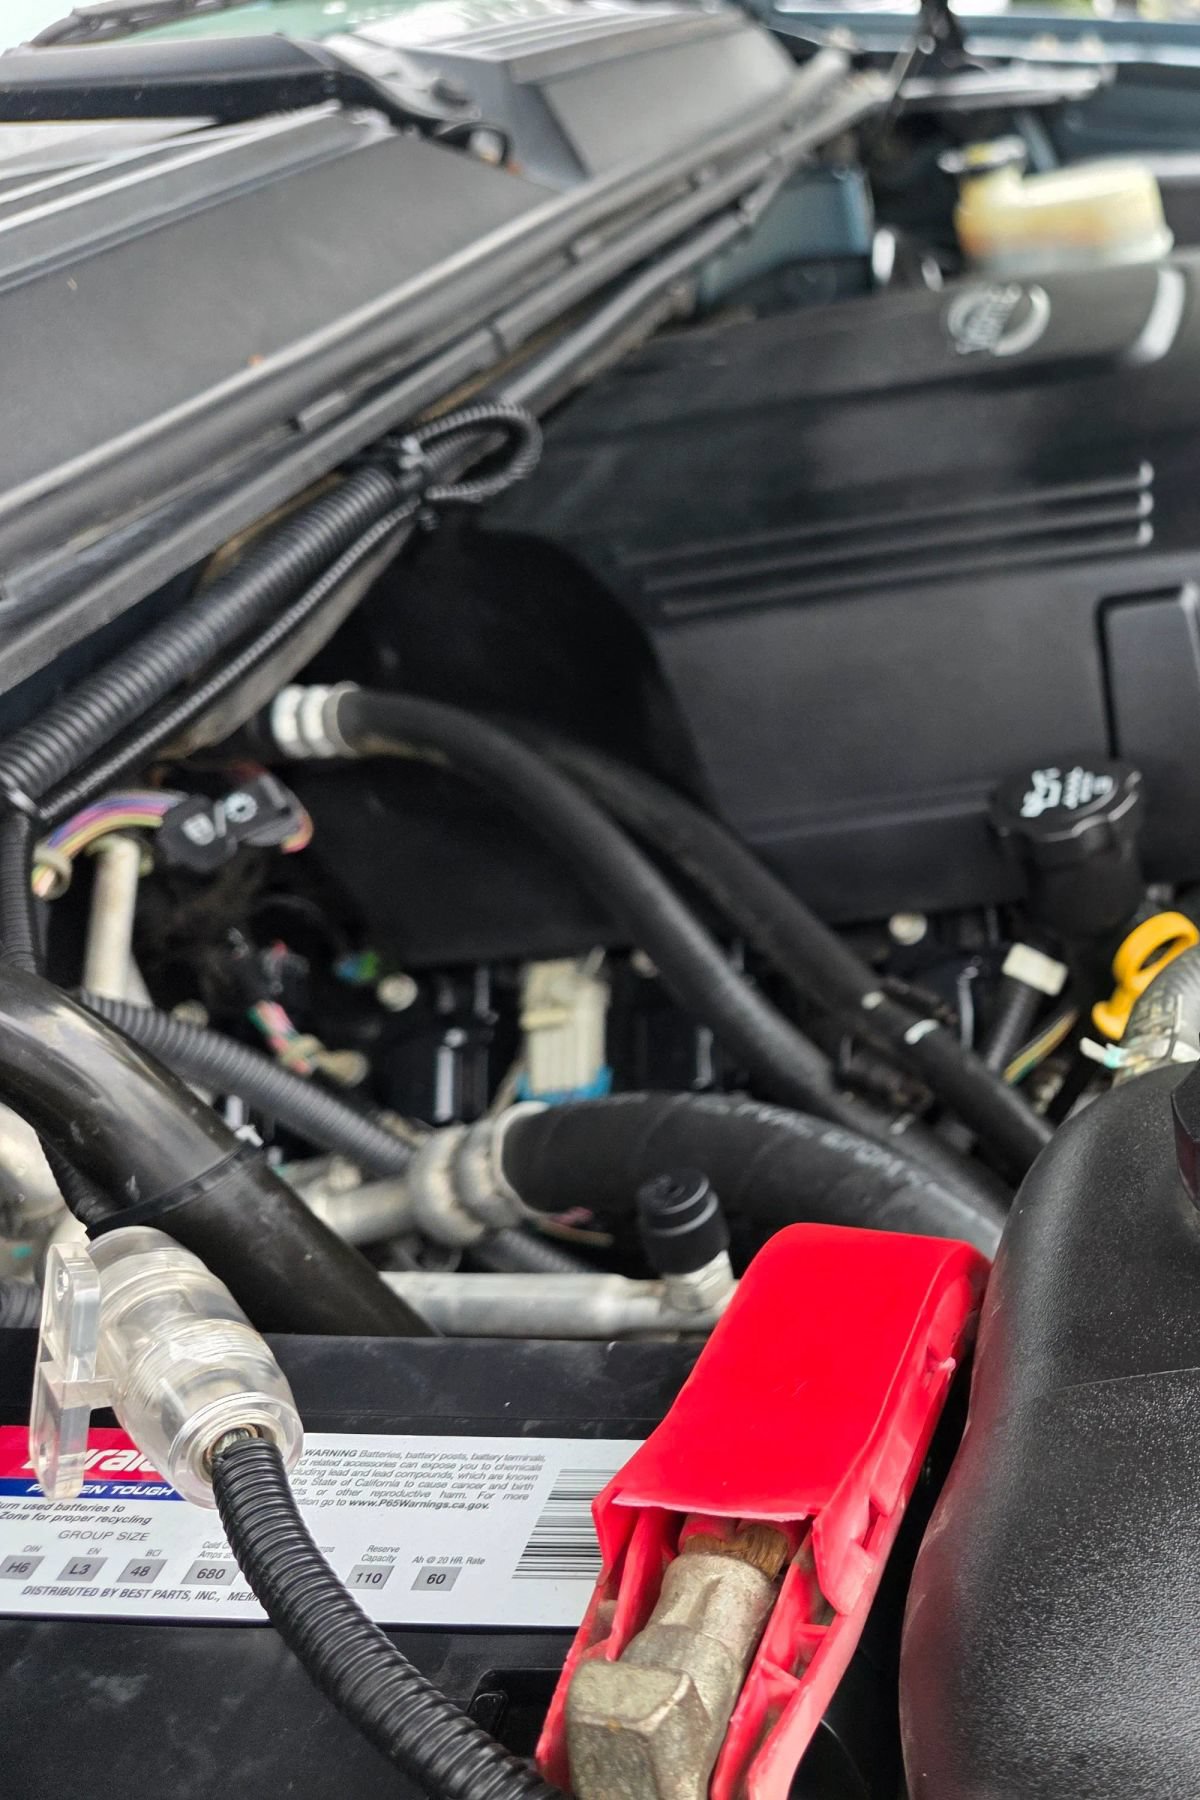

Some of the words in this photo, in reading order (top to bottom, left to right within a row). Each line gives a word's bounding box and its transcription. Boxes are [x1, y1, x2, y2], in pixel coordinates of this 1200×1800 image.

[304, 1449, 357, 1458] WARNING
[404, 1452, 438, 1461] battery
[309, 1459, 340, 1467] related
[343, 1460, 397, 1468] accessories
[421, 1462, 456, 1470] expose
[458, 1463, 478, 1471] you
[481, 1462, 491, 1470] to
[494, 1463, 543, 1471] chemicals
[351, 1469, 371, 1477] and
[372, 1469, 394, 1477] lead
[395, 1471, 454, 1480] compounds,
[458, 1471, 486, 1480] which
[505, 1472, 538, 1480] known
[311, 1478, 337, 1486] State
[341, 1478, 352, 1486] of
[355, 1479, 400, 1487] California
[418, 1481, 447, 1489] cause
[489, 1482, 508, 1490] and
[511, 1482, 534, 1490] birth
[111, 1485, 176, 1496] TOUGH
[336, 1488, 362, 1496] other
[370, 1489, 431, 1498] reproductive
[439, 1490, 467, 1499] harm.
[477, 1491, 495, 1500] For
[22, 1502, 55, 1511] used
[54, 1502, 109, 1512] batteries
[113, 1504, 125, 1512] to
[349, 1500, 490, 1511] www.P65Warnings.ca.gov.
[0, 1511, 29, 1520] Zone
[31, 1512, 51, 1521] for
[49, 1513, 94, 1524] proper
[95, 1516, 152, 1526] recycling
[58, 1530, 113, 1540] GROUP
[117, 1531, 150, 1542] SIZE
[86, 1547, 102, 1555] EN
[367, 1545, 400, 1553] Reserve
[361, 1554, 397, 1563] Capacity
[437, 1556, 449, 1564] 20
[466, 1557, 486, 1565] Rate
[6, 1562, 31, 1573] H6
[69, 1564, 91, 1575] L3
[131, 1566, 152, 1577] 48
[197, 1568, 226, 1580] 680
[356, 1573, 383, 1584] 110
[426, 1574, 446, 1585] 60
[21, 1585, 98, 1597] DISTRIBUTED
[101, 1587, 120, 1597] BY
[121, 1588, 151, 1598] BEST
[151, 1590, 191, 1601] PARTS,
